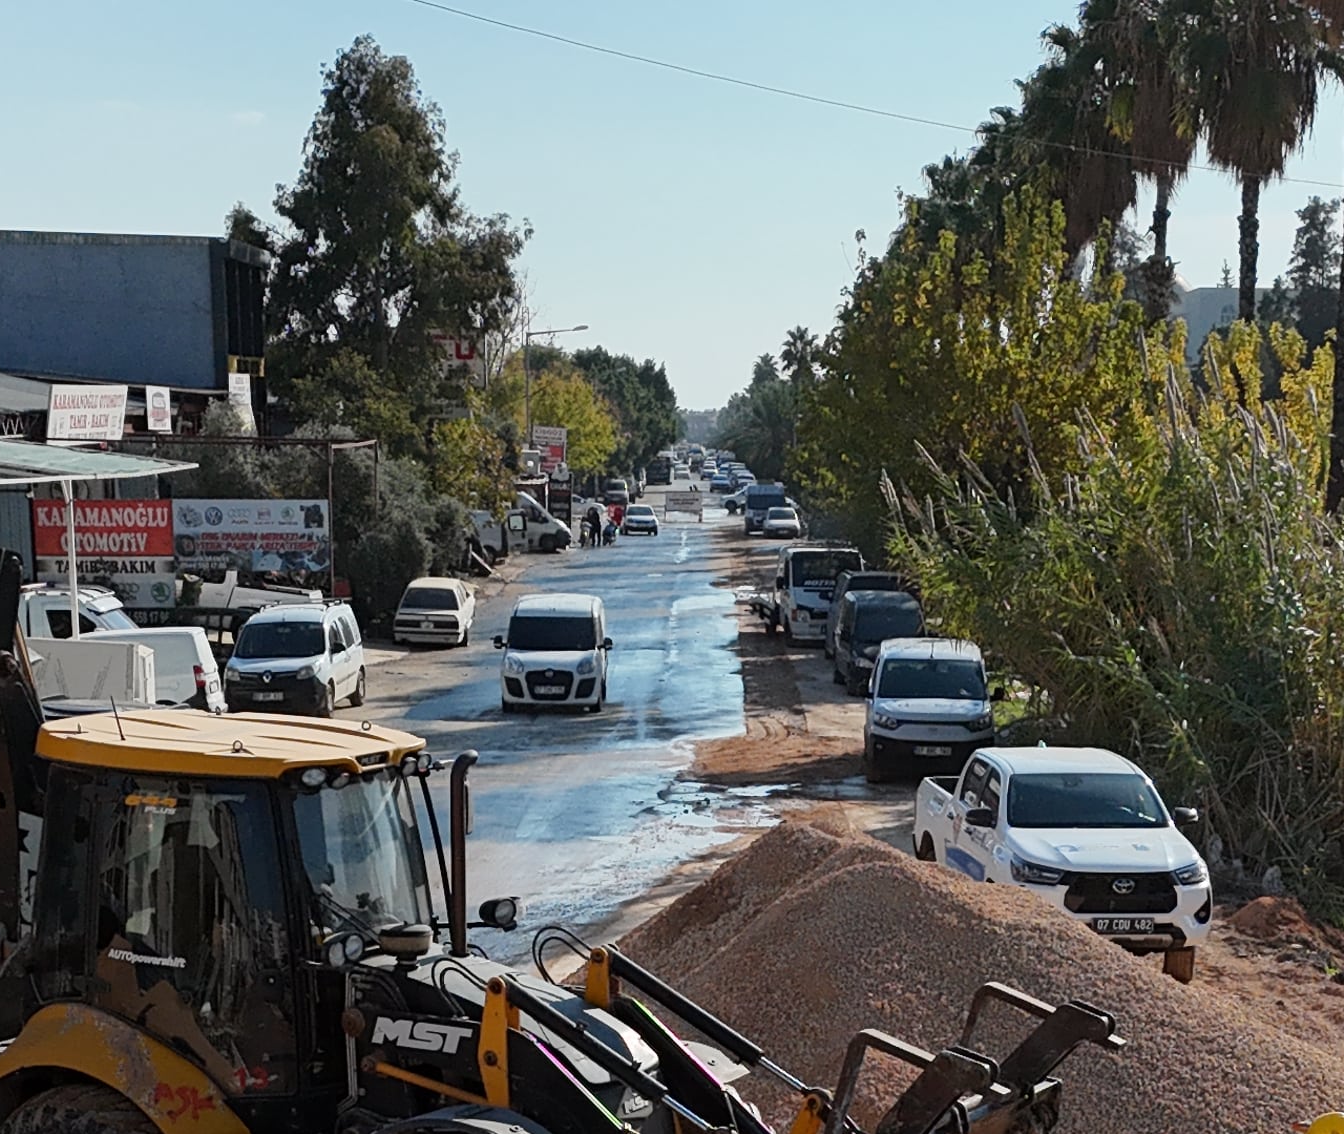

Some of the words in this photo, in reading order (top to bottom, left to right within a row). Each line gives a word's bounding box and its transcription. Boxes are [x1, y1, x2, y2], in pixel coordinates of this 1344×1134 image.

[1097, 919, 1109, 930] 07
[1135, 919, 1152, 930] 482
[371, 1015, 473, 1054] MST
